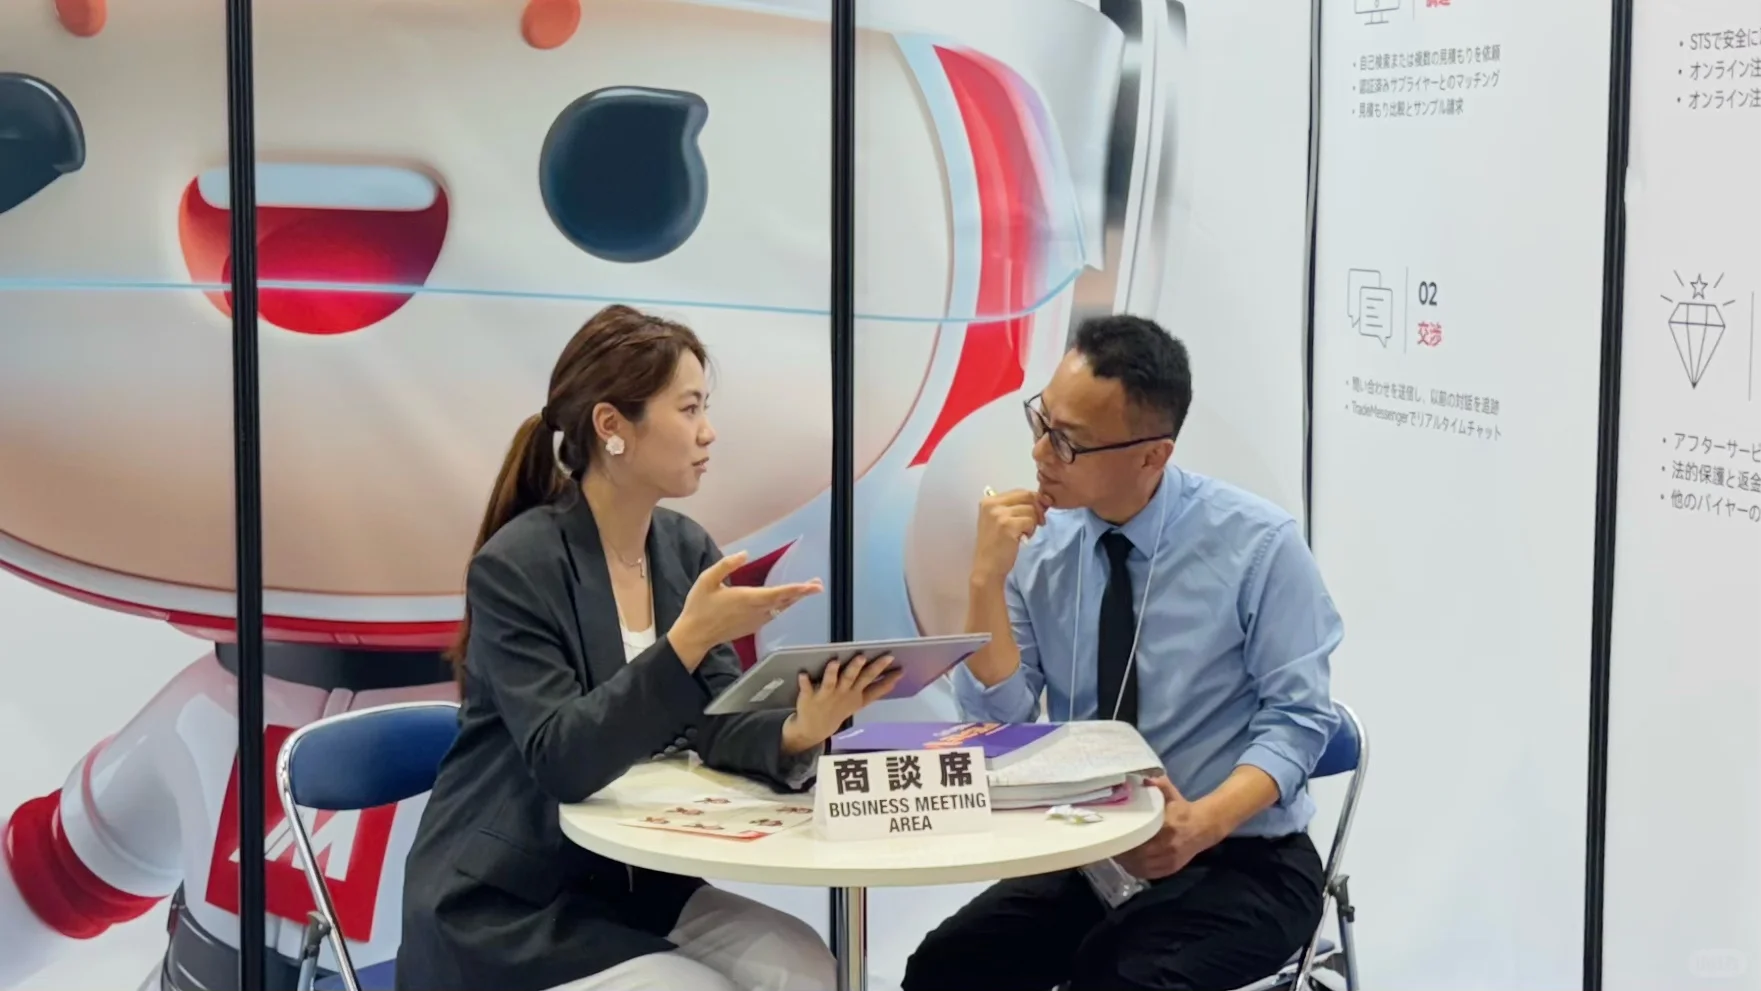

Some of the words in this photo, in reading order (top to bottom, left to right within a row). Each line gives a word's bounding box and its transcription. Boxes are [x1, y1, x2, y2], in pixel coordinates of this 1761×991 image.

[1690, 27, 1761, 50] STSで安全に
[1418, 281, 1437, 306] 02
[1417, 321, 1442, 347] 交渉
[833, 751, 972, 794] 商談席
[829, 797, 911, 818] BUSINESS
[915, 792, 986, 812] MEETING
[889, 815, 933, 833] AREA
